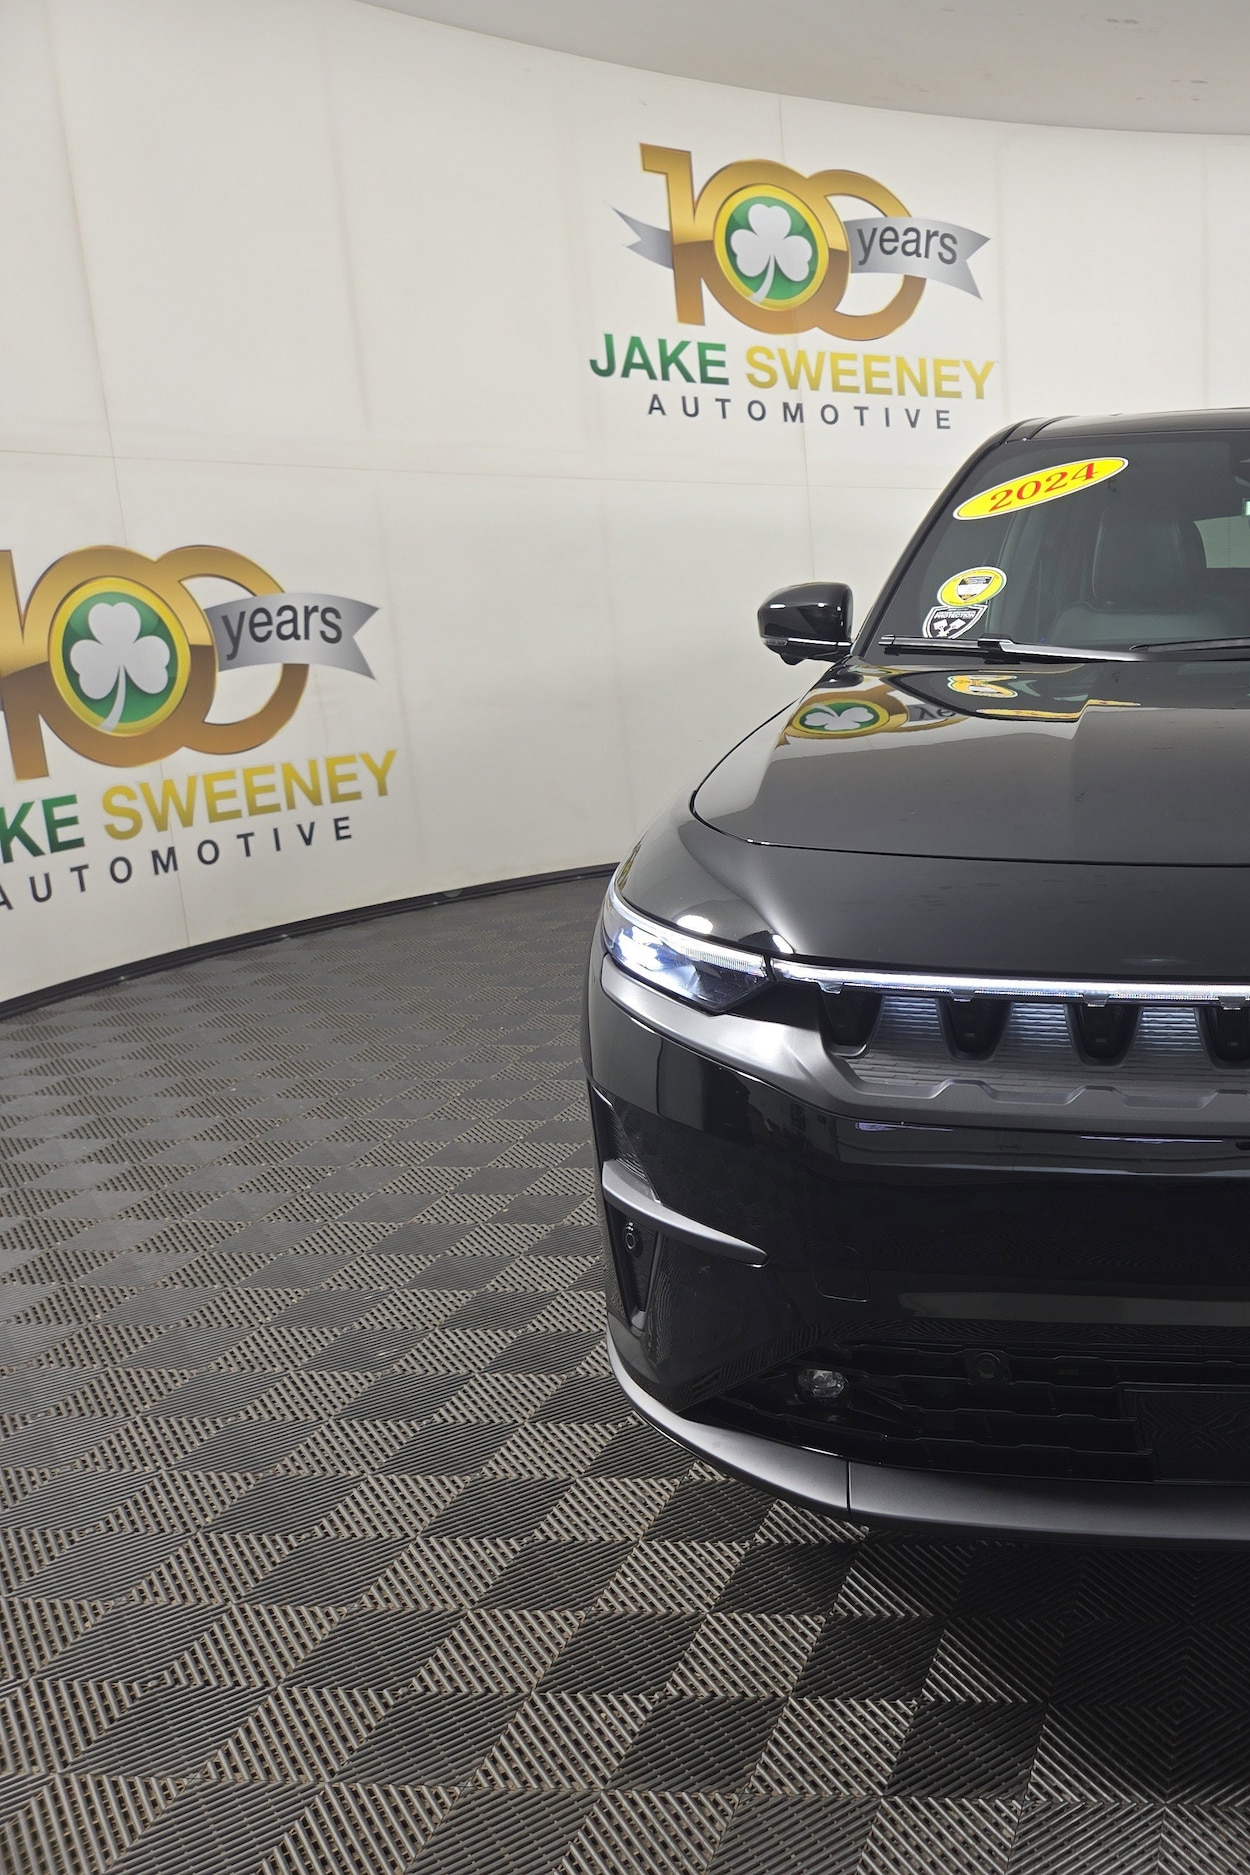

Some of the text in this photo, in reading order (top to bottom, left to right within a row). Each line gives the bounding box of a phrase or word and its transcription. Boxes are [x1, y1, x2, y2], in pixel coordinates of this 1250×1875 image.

[639, 143, 958, 341] 100 years
[589, 334, 996, 400] JAKE SWEENEY
[647, 394, 952, 430] AUTOMOTIVE
[988, 462, 1099, 512] 2024
[221, 604, 343, 660] years
[0, 750, 397, 864] KE SWEENEY
